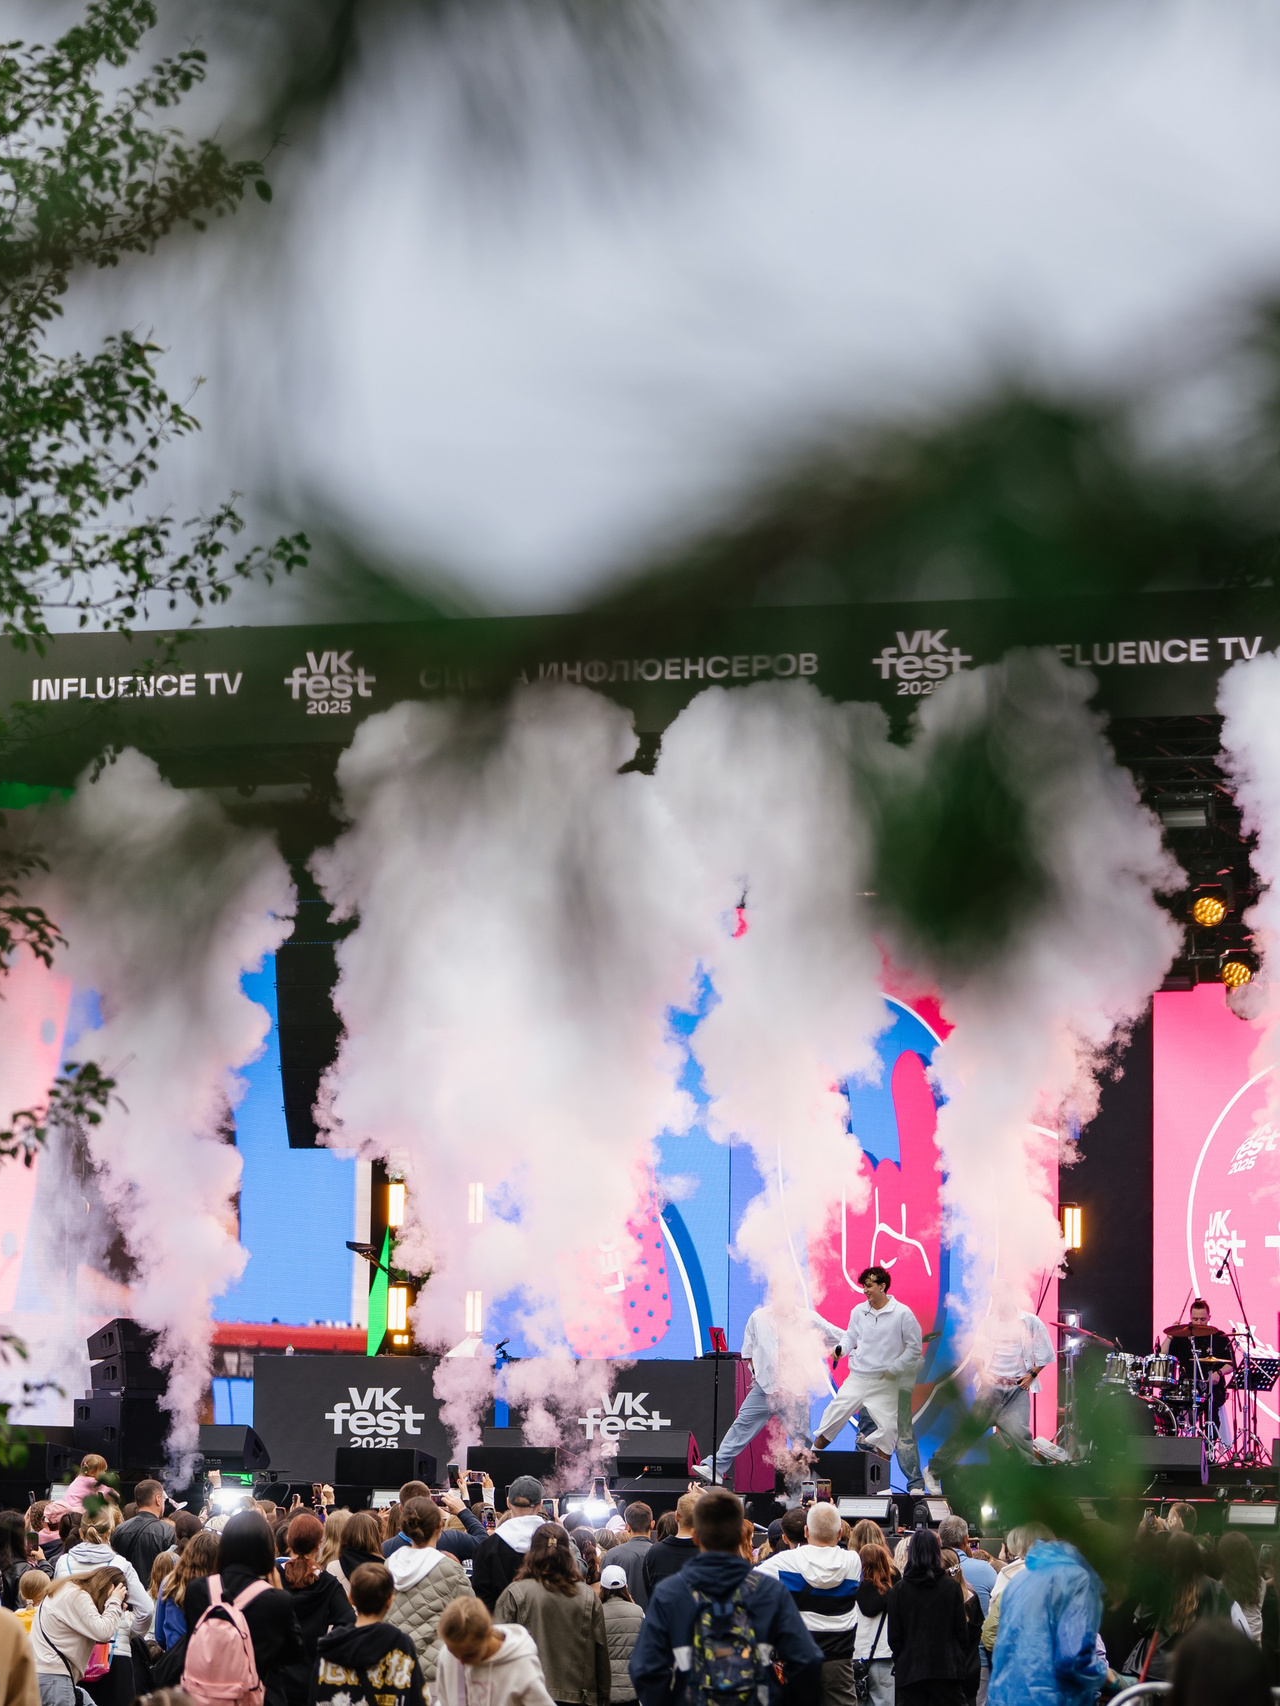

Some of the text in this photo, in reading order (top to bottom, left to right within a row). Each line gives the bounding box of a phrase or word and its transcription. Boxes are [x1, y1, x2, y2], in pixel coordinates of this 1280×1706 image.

[896, 629, 949, 653] VK
[1054, 635, 1263, 666] FLUENCE TV
[306, 651, 355, 674] VK
[872, 647, 973, 679] fest
[32, 672, 243, 700] INFLUENCE TV
[284, 667, 376, 699] fest
[306, 700, 352, 715] 2025
[1209, 1209, 1232, 1237] VK
[1203, 1229, 1246, 1267] fest
[348, 1387, 402, 1411] VK
[600, 1392, 650, 1415] VK
[324, 1402, 425, 1436] fest
[578, 1407, 672, 1440] fest
[349, 1437, 399, 1449] 2025
